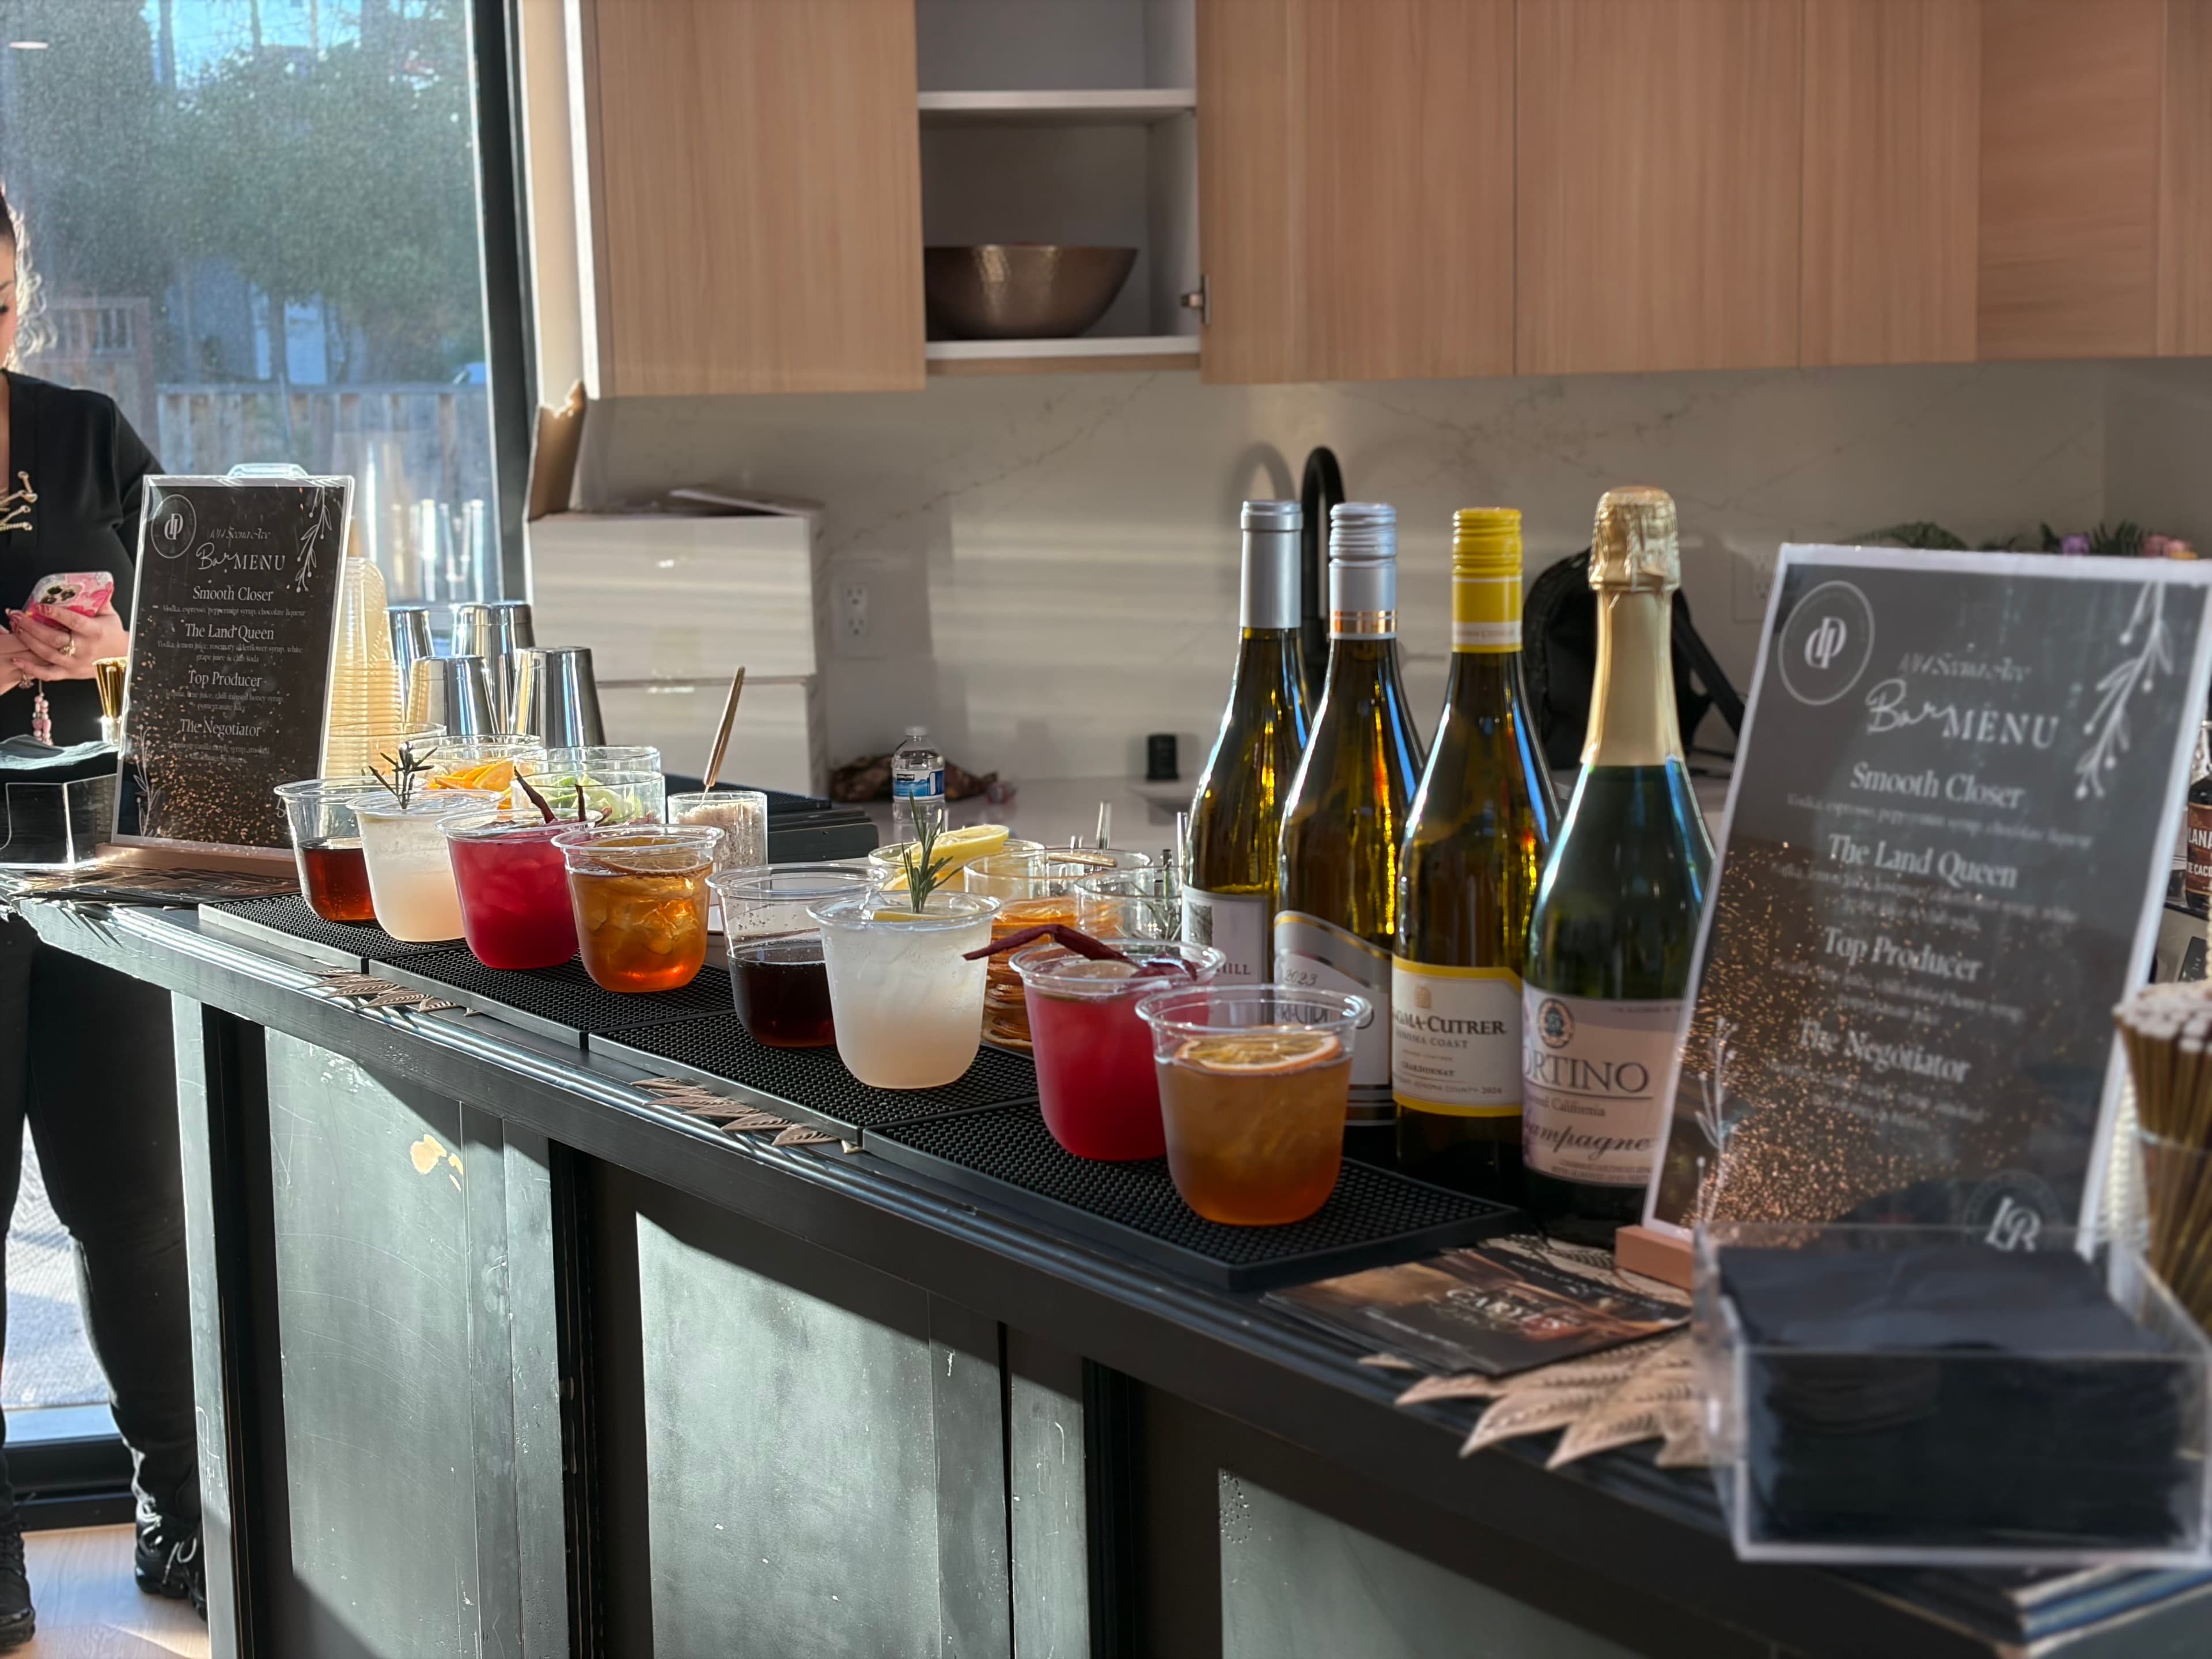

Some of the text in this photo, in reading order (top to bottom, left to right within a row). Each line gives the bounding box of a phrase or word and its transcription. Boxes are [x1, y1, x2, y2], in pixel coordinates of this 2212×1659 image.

[195, 542, 286, 571] Bar MENU
[192, 585, 274, 602] Smooth Closer
[185, 623, 274, 643] The Land Queen
[188, 669, 263, 689] Top Producer
[179, 717, 263, 738] The Negotiator
[1865, 678, 2061, 749] Bar MENU
[1850, 762, 2026, 810] Smooth Closer
[1828, 832, 2019, 889] The Land Queen
[1823, 926, 1984, 983] Top Producer
[1799, 1017, 1973, 1084] The Negotiator
